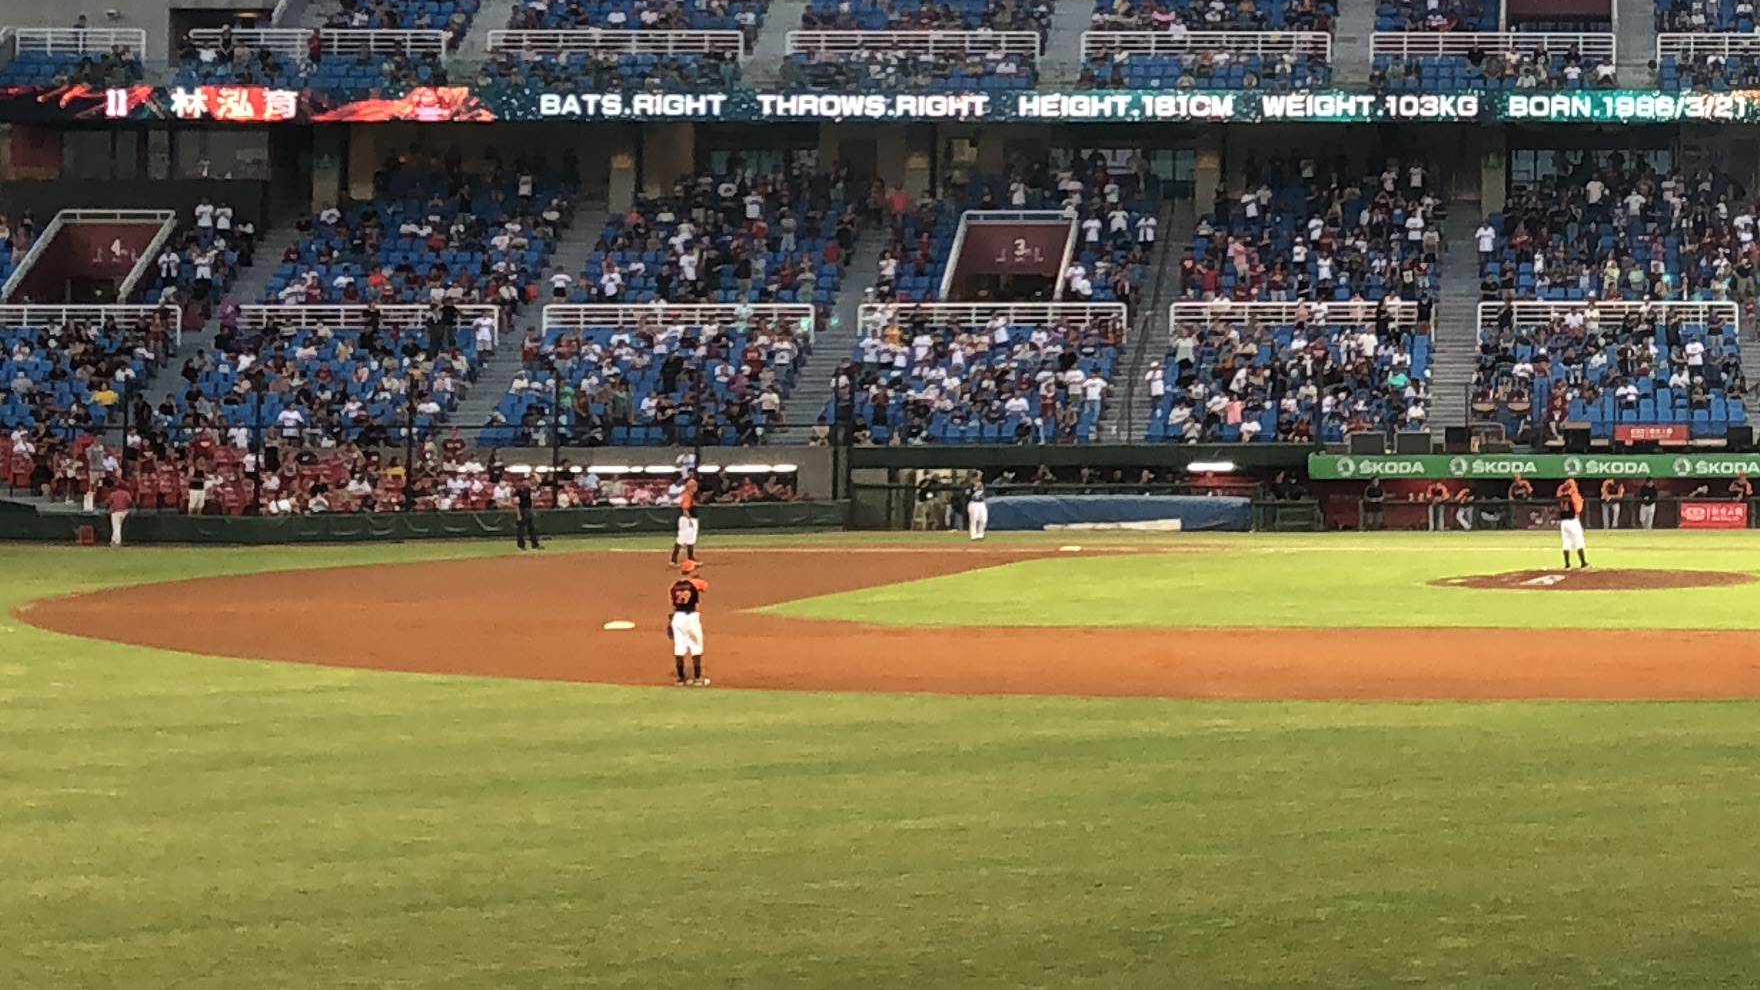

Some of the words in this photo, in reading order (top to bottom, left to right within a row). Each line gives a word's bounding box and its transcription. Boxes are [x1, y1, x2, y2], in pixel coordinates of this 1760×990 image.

[540, 94, 727, 116] BATS.RIGHT
[757, 94, 990, 117] THROWS.RIGHT
[1018, 95, 1234, 117] HEIGHT.181CM
[1262, 95, 1478, 117] WEIGHT.103KG
